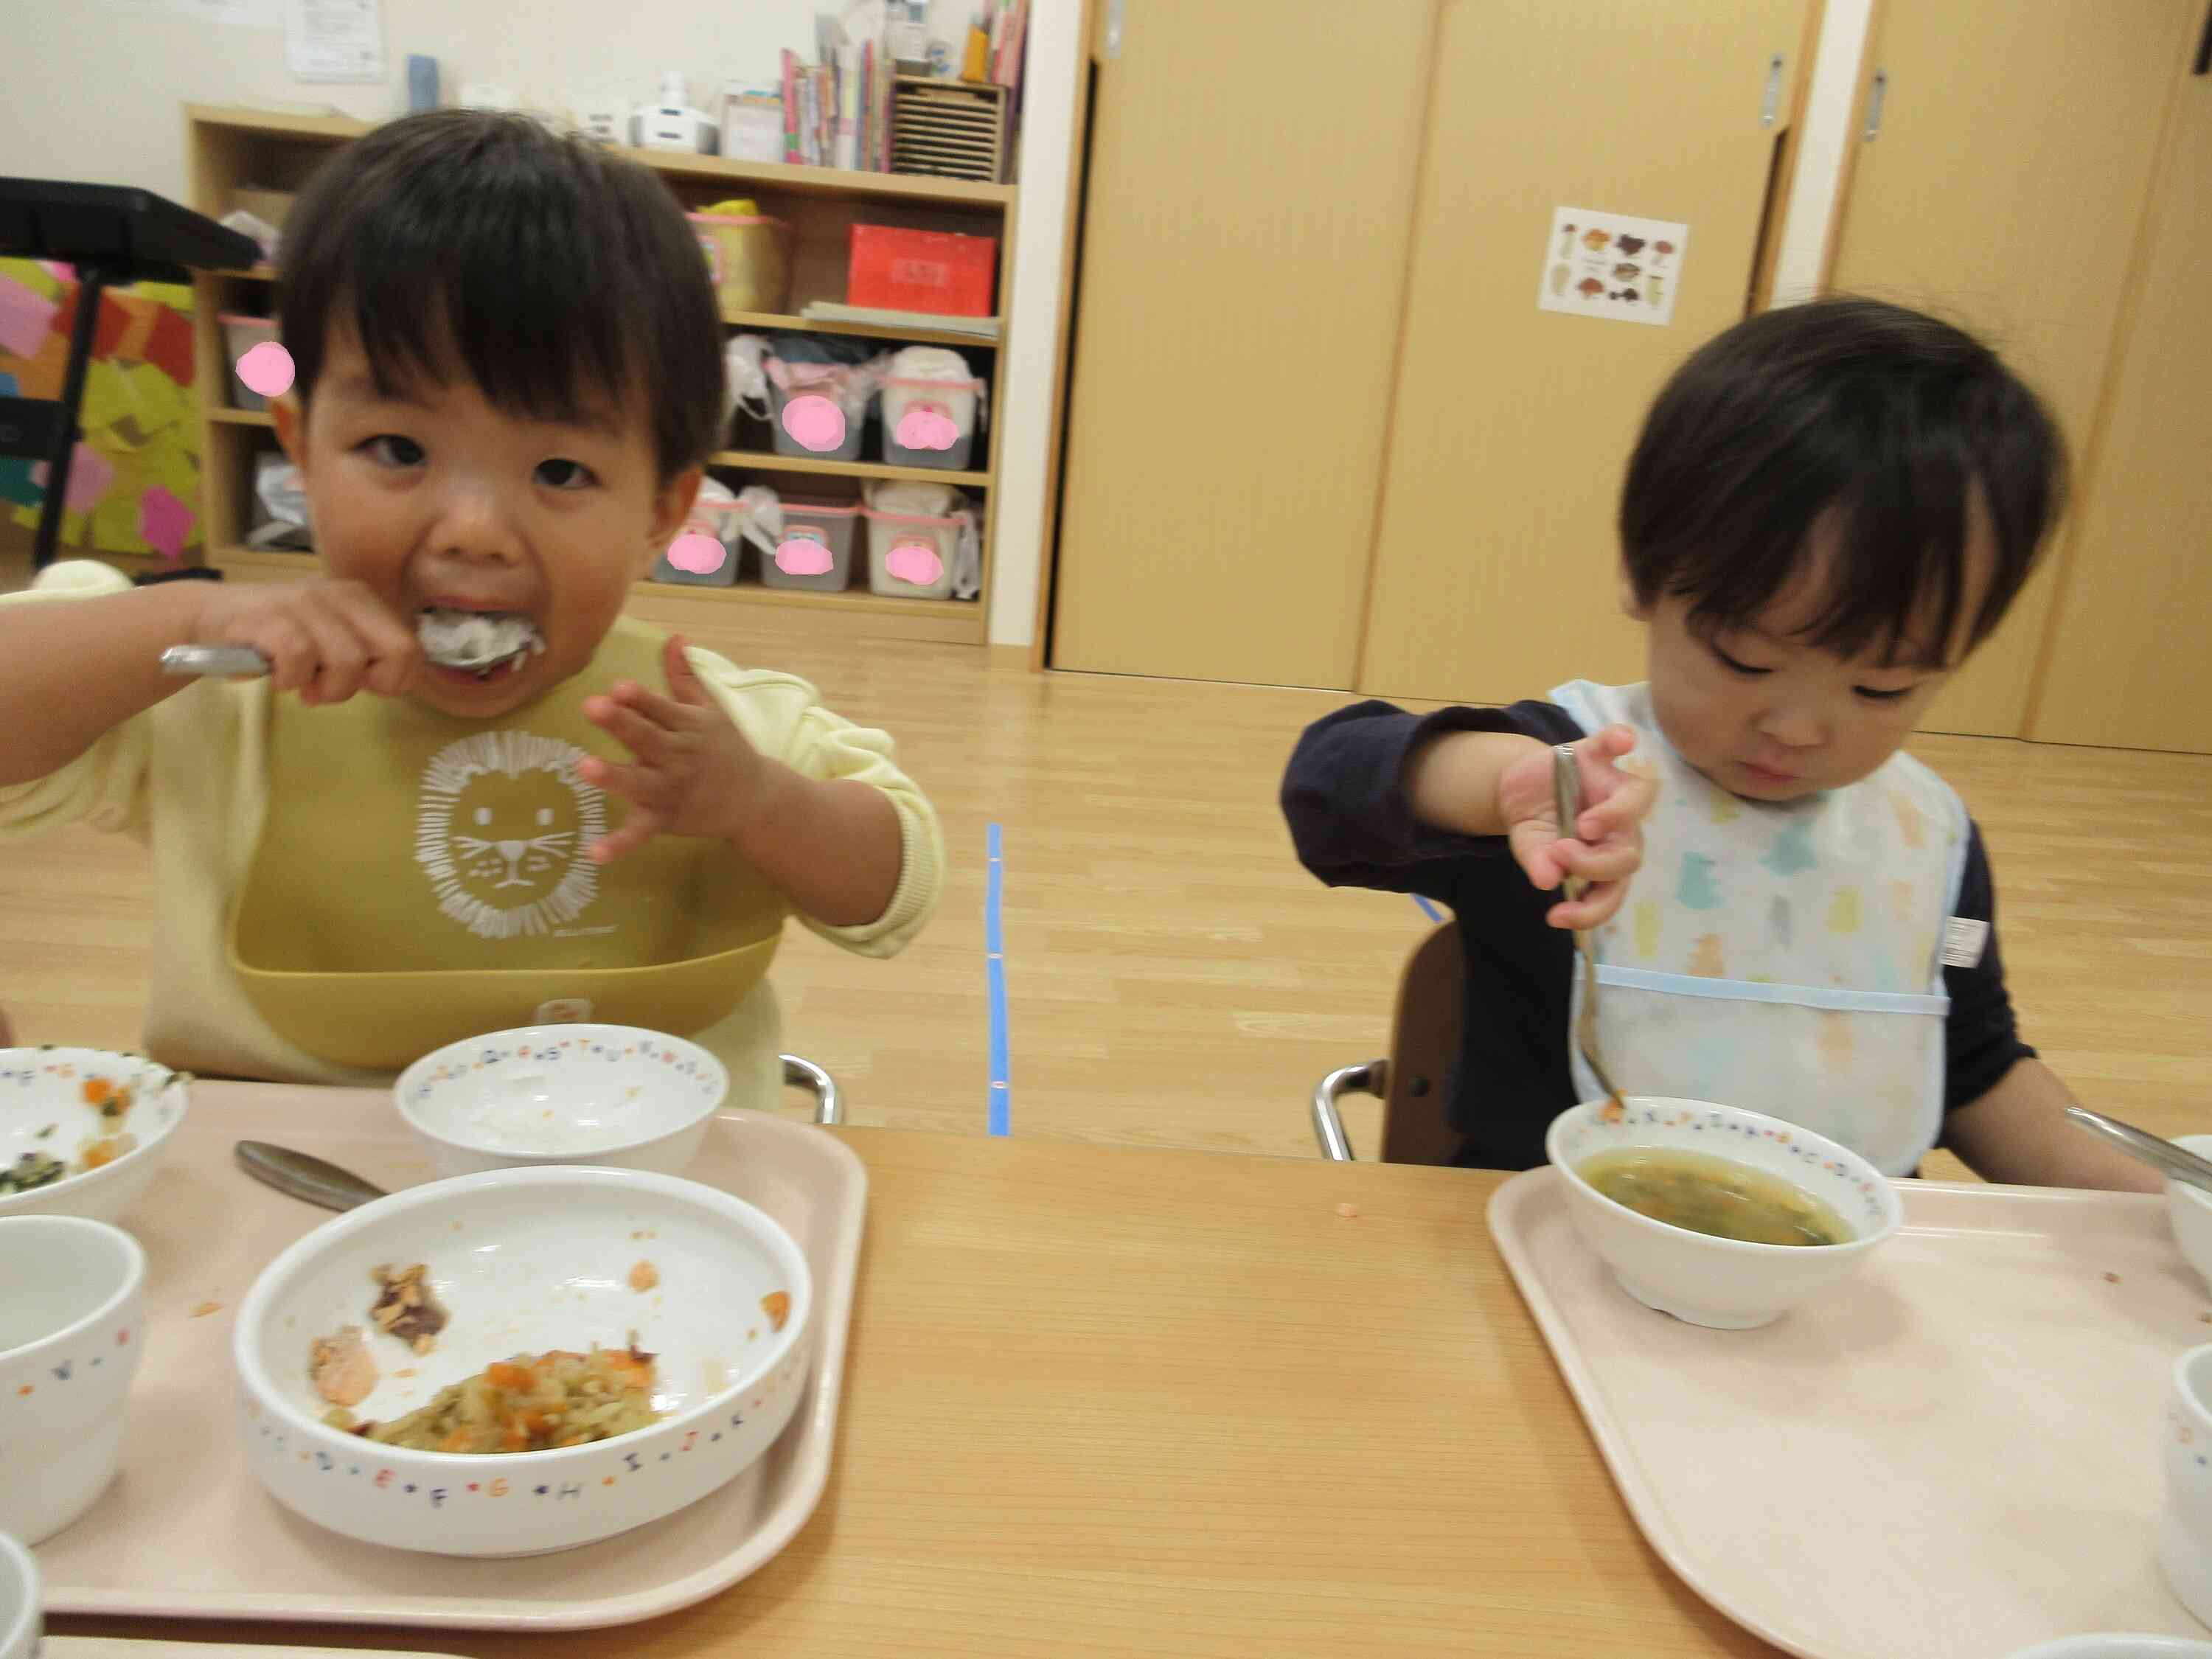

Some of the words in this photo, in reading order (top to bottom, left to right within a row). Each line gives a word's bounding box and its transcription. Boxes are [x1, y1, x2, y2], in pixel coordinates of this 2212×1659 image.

[373, 1467, 398, 1489] E
[430, 1487, 448, 1509] F
[489, 1477, 510, 1498] G
[557, 1481, 585, 1500] H
[623, 1451, 643, 1472] I
[679, 1430, 699, 1452] J
